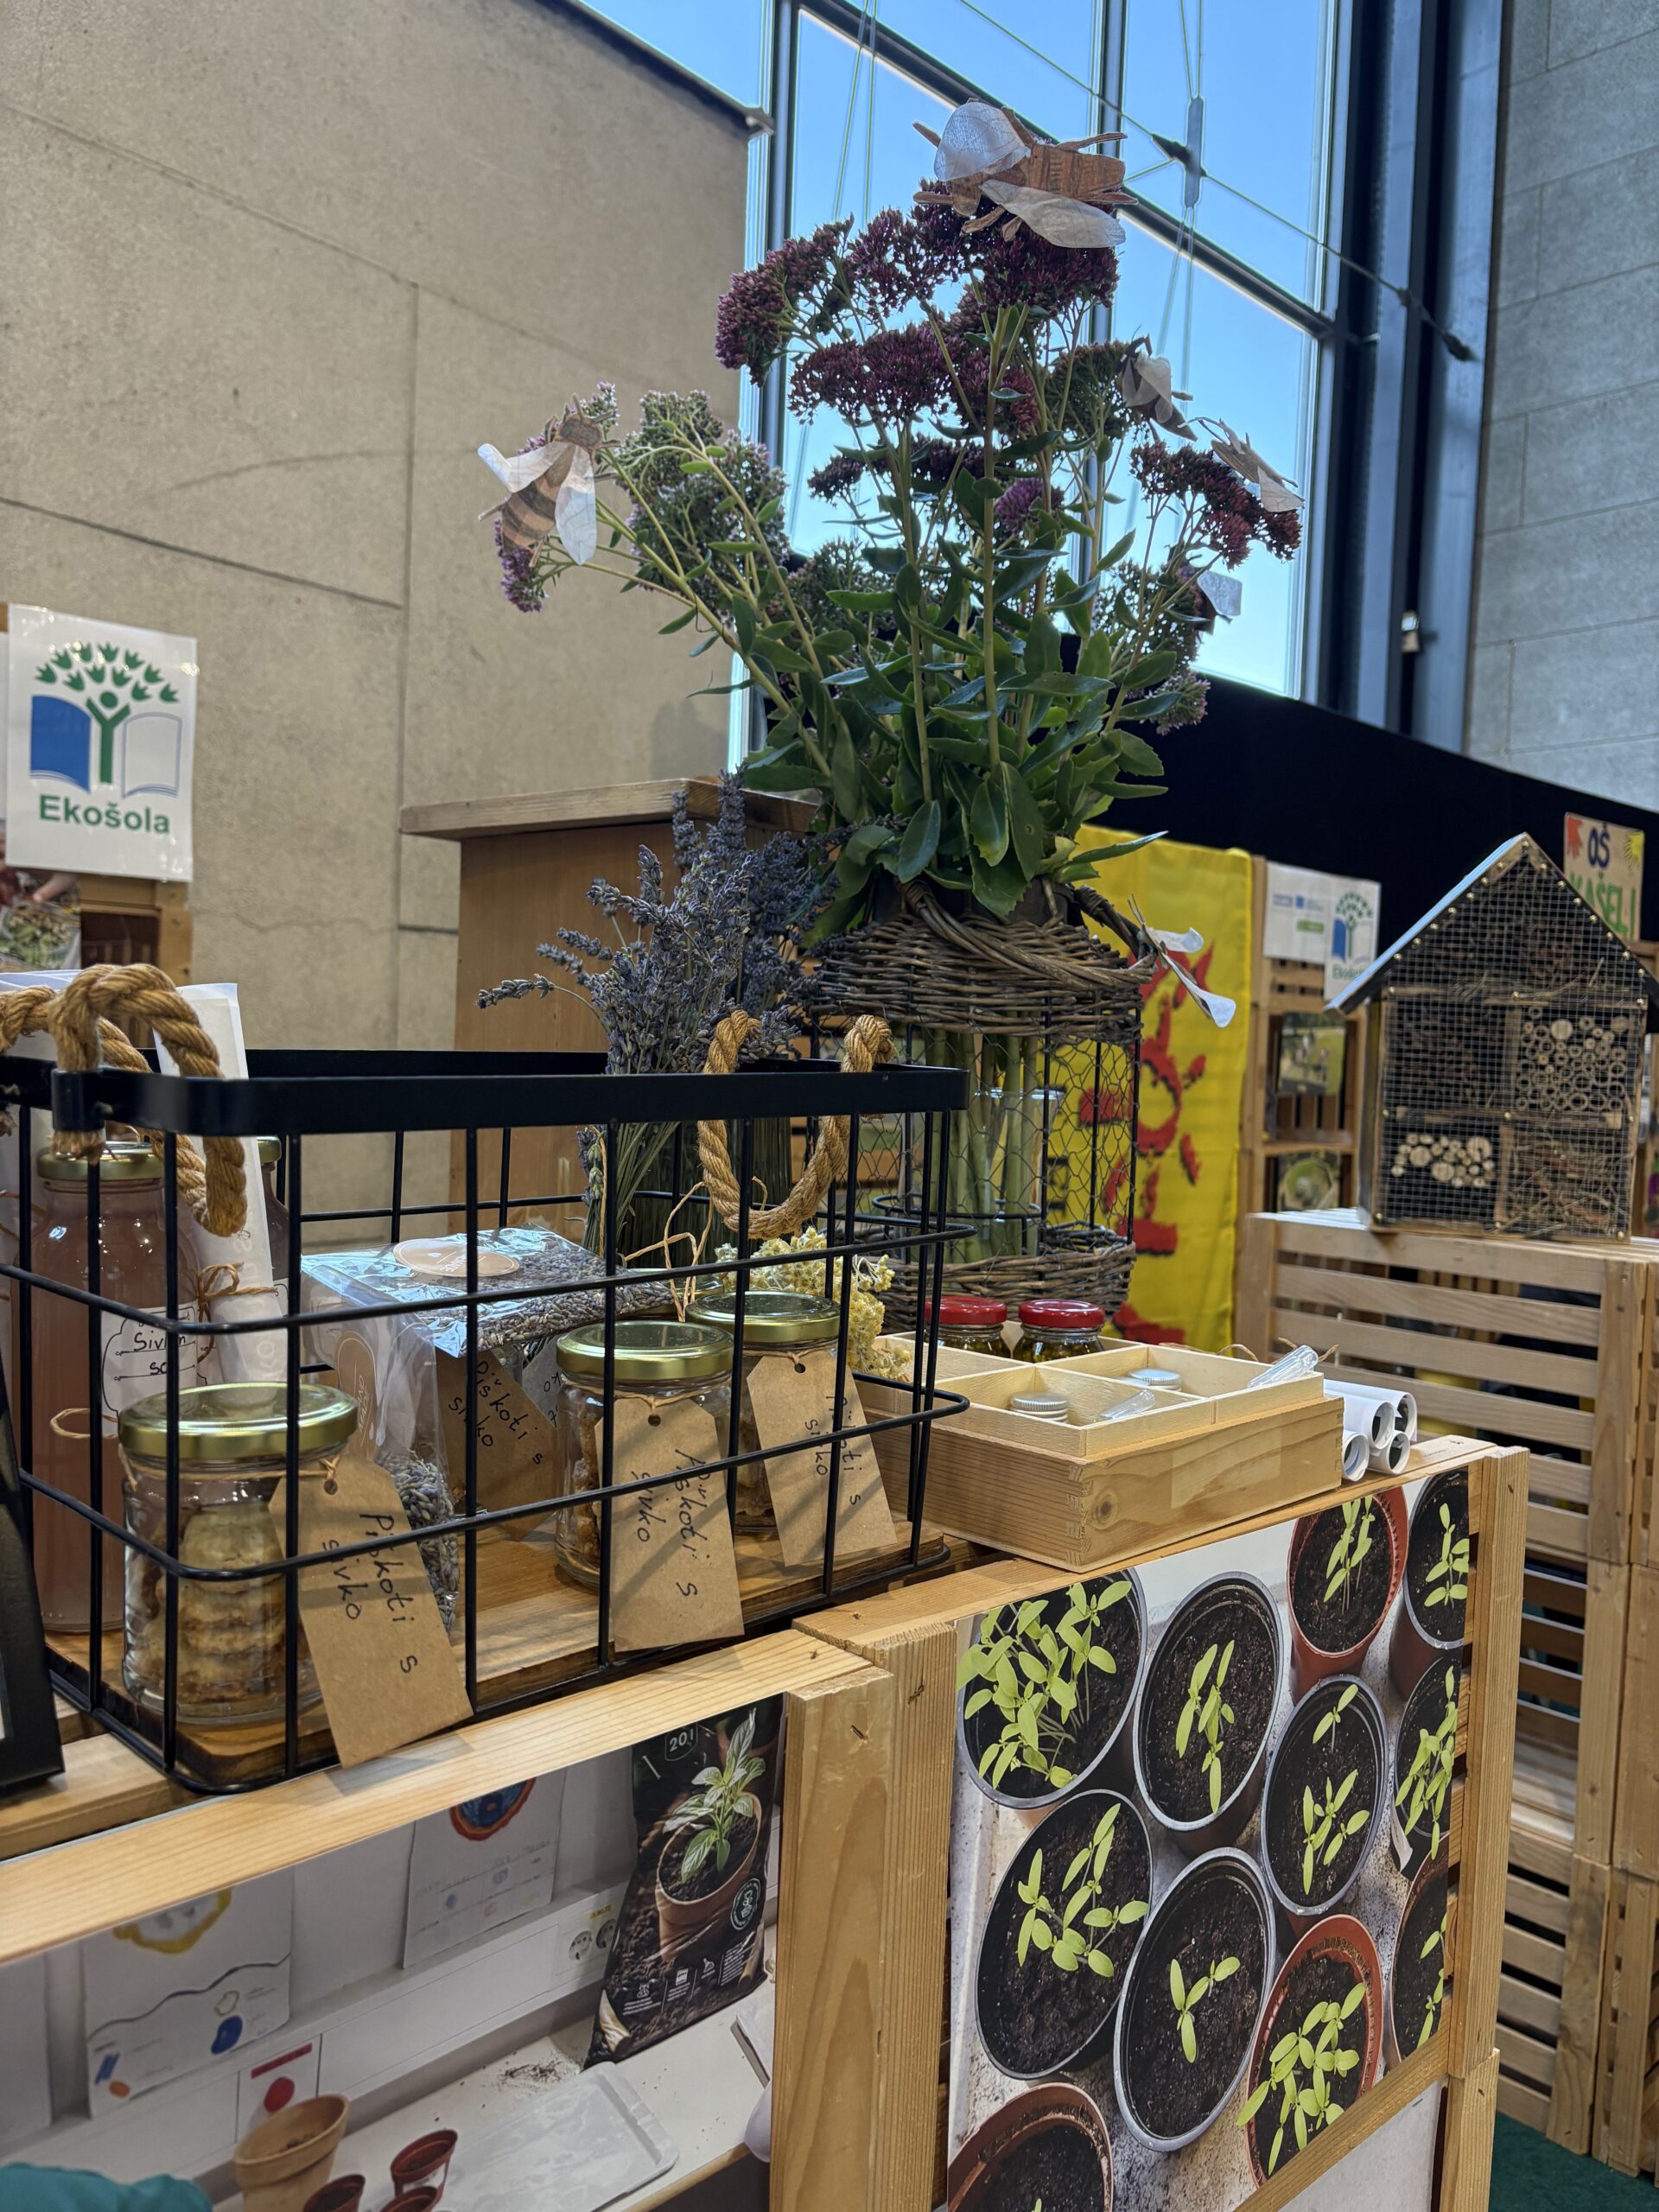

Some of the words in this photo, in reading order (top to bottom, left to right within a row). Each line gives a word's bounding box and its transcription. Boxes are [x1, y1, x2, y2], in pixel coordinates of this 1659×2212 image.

[40, 794, 170, 834] Ekošola
[134, 1332, 186, 1351] Sivn
[448, 1396, 493, 1447] siko
[804, 1418, 831, 1476] siko
[825, 1395, 862, 1472] Pioti
[849, 1493, 861, 1506] s
[532, 1452, 543, 1465] s
[676, 1581, 698, 1598] s
[400, 1655, 418, 1675] s
[669, 1732, 688, 1752] 20
